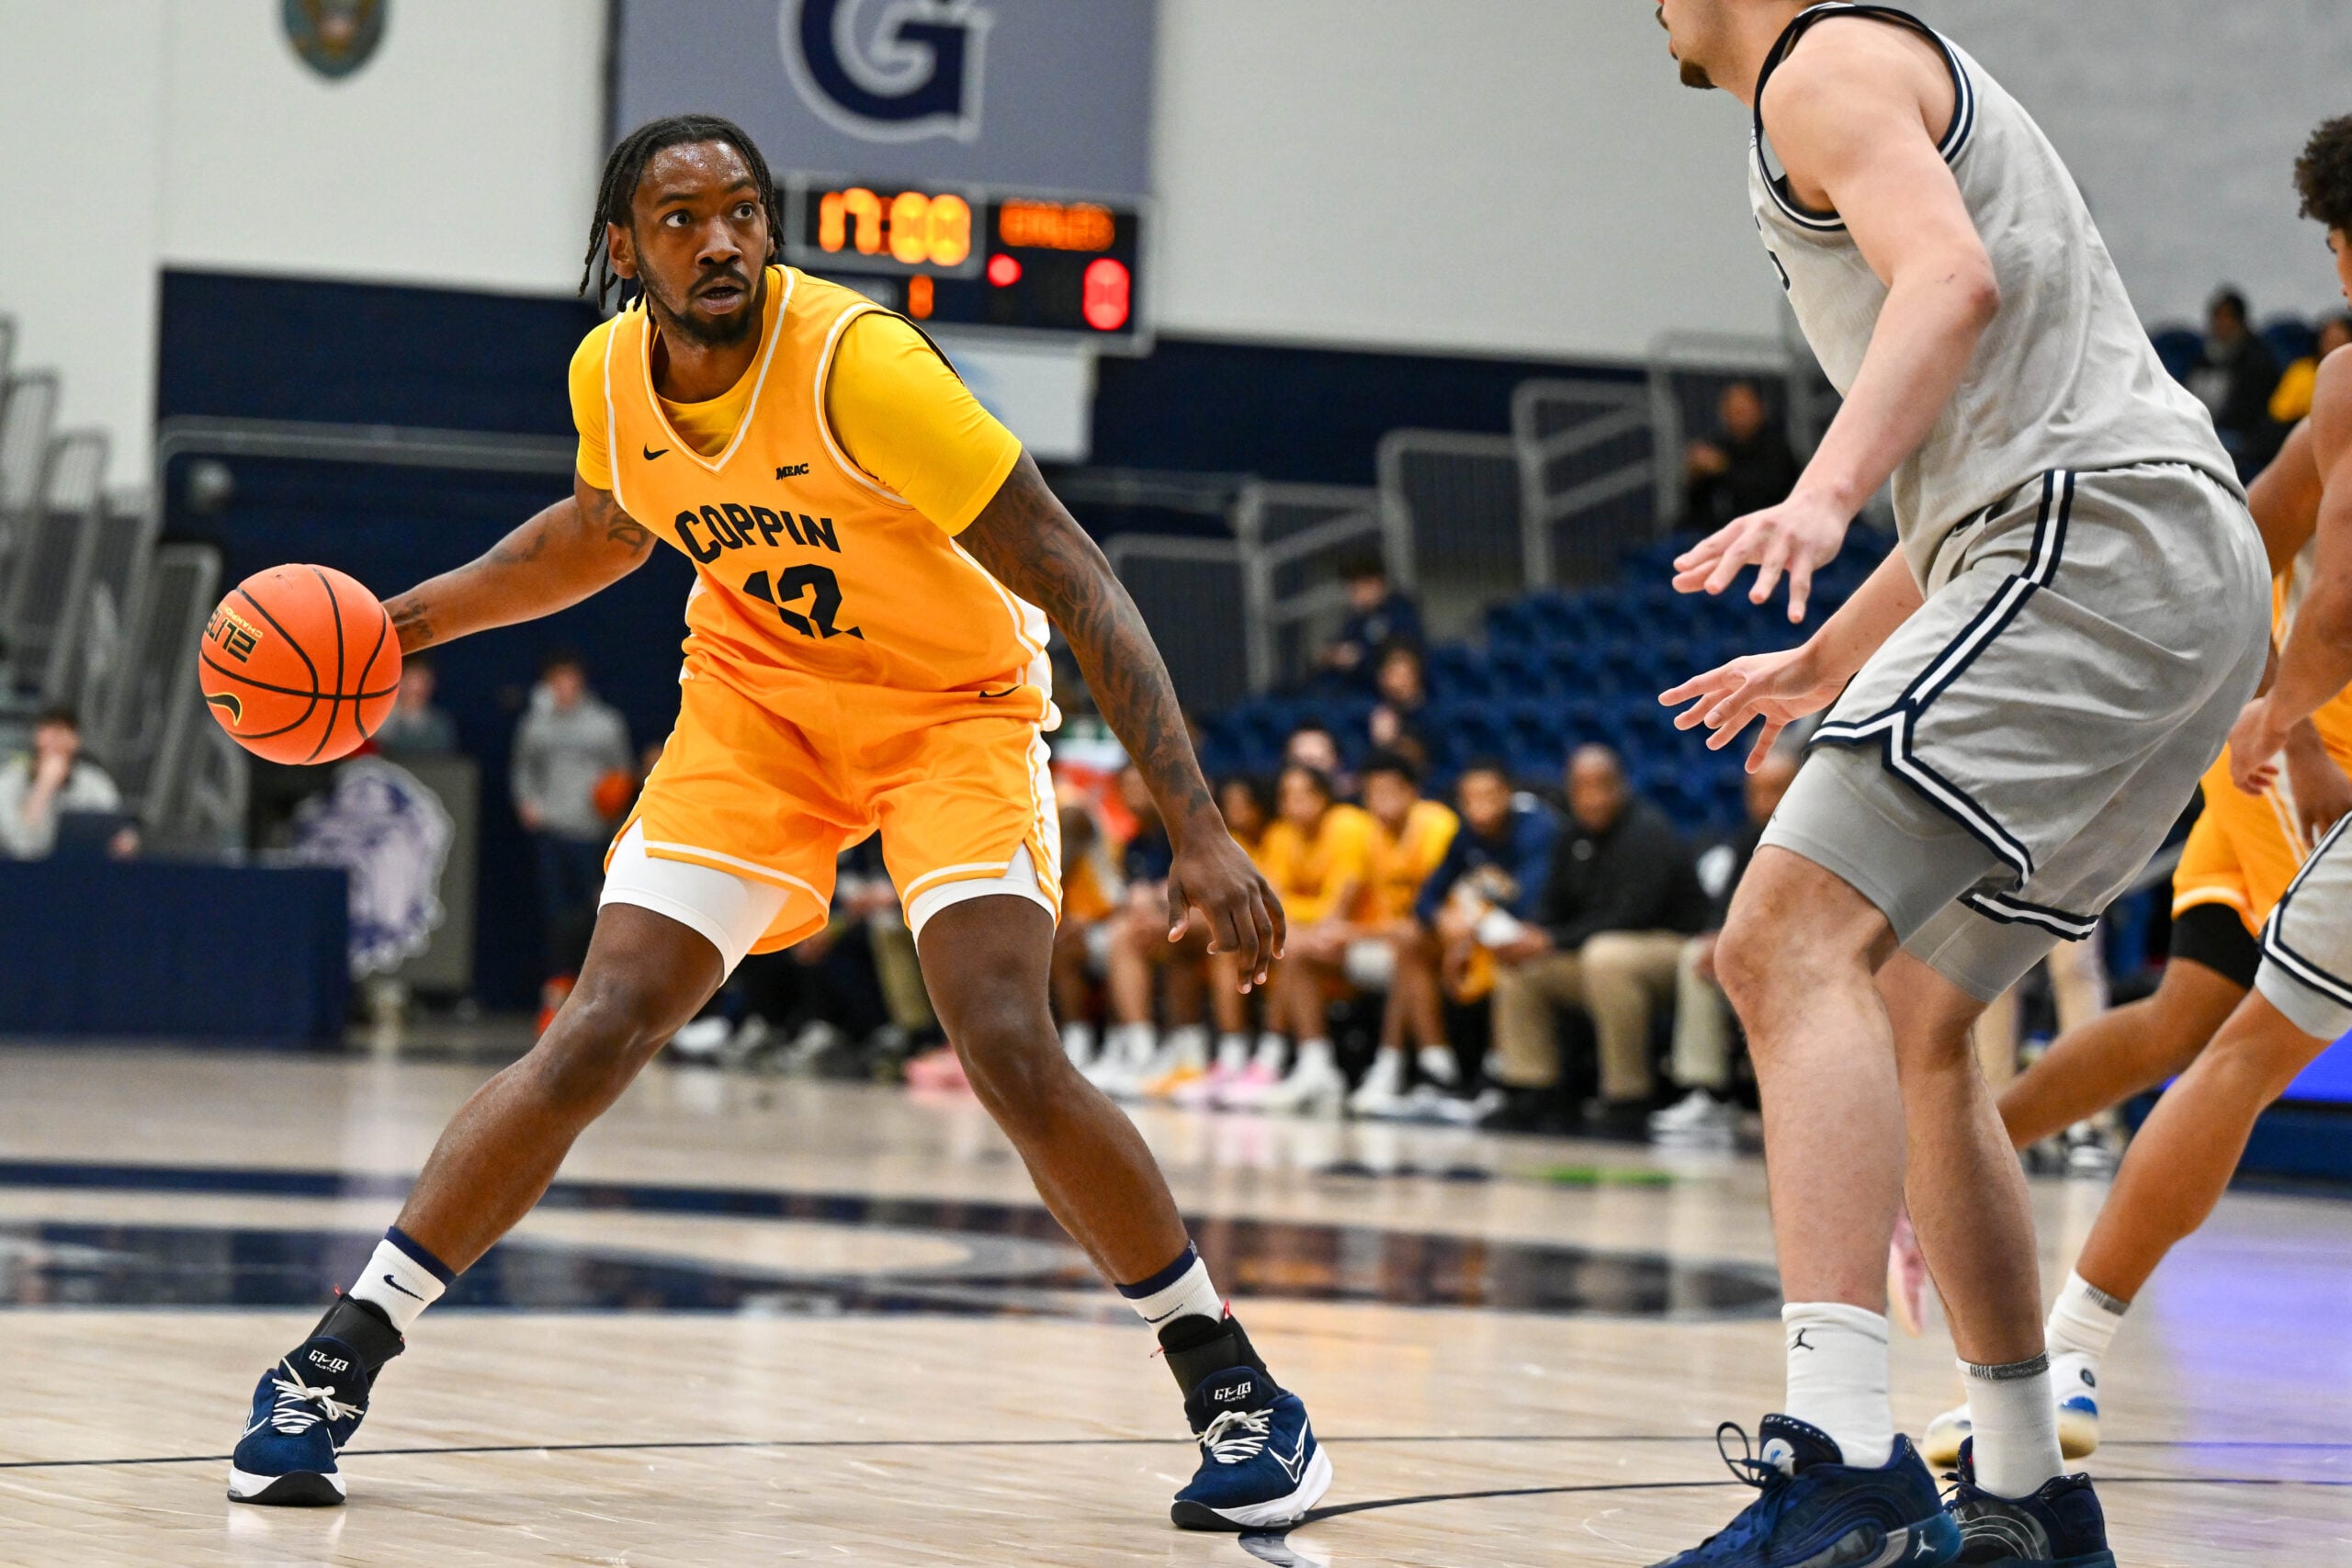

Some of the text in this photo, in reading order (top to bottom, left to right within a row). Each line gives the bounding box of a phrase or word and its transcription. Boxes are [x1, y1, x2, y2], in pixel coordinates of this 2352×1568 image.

[779, 0, 992, 141] G
[775, 462, 809, 480] MEAC
[674, 502, 842, 564] COPPIN
[742, 563, 865, 641] 12
